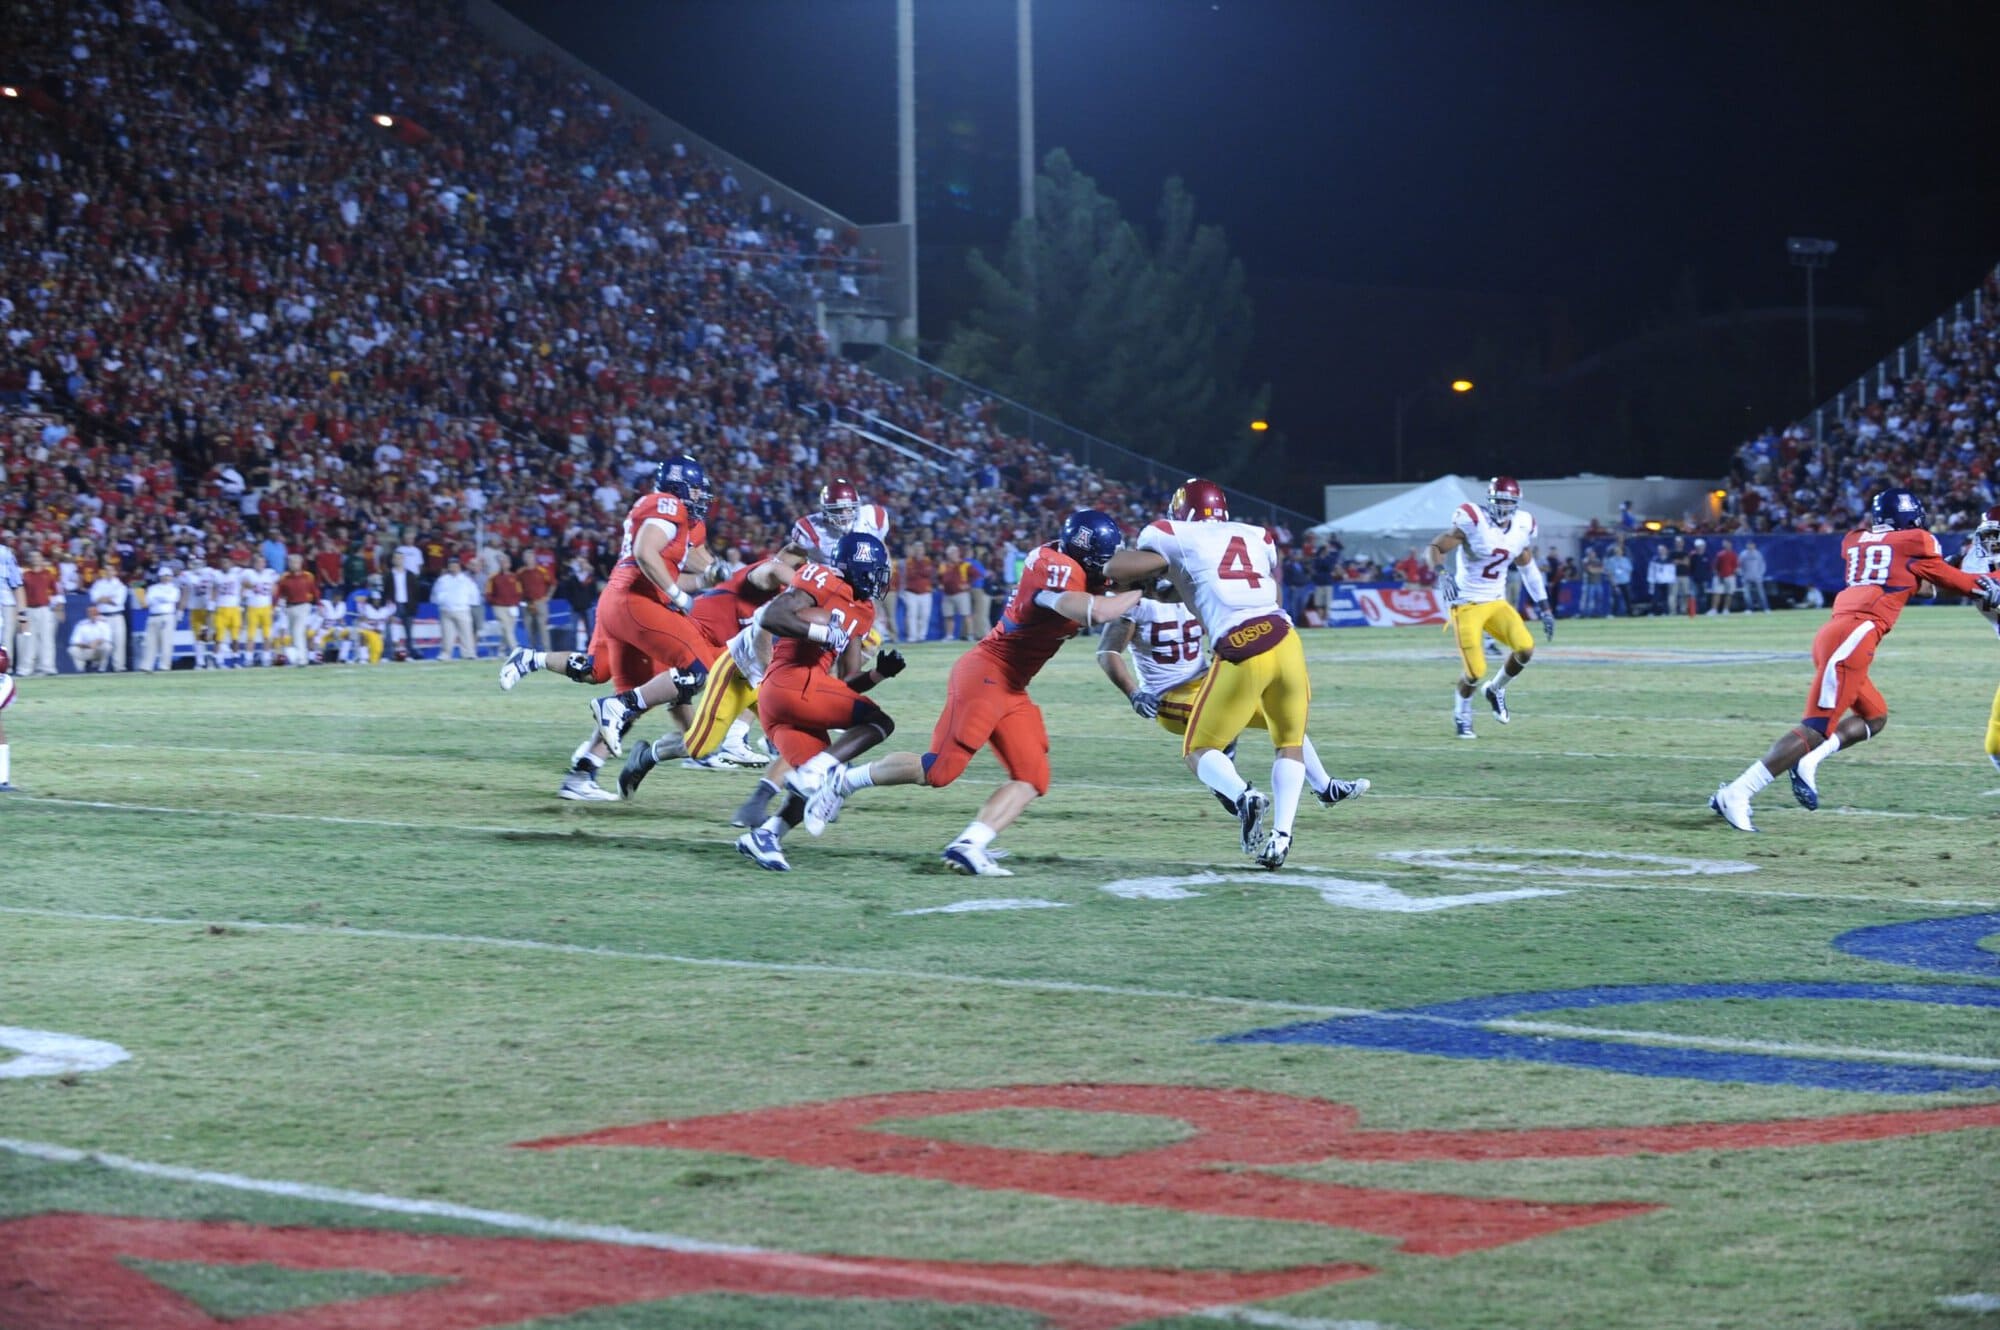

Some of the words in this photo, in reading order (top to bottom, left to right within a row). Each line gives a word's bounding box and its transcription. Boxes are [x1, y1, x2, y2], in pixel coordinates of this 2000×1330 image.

[853, 541, 873, 562] A
[1217, 536, 1264, 589] 4
[1482, 547, 1510, 580] 2
[1846, 544, 1892, 587] 18
[801, 563, 829, 588] 84
[1046, 564, 1072, 588] 37
[1229, 620, 1273, 648] USC
